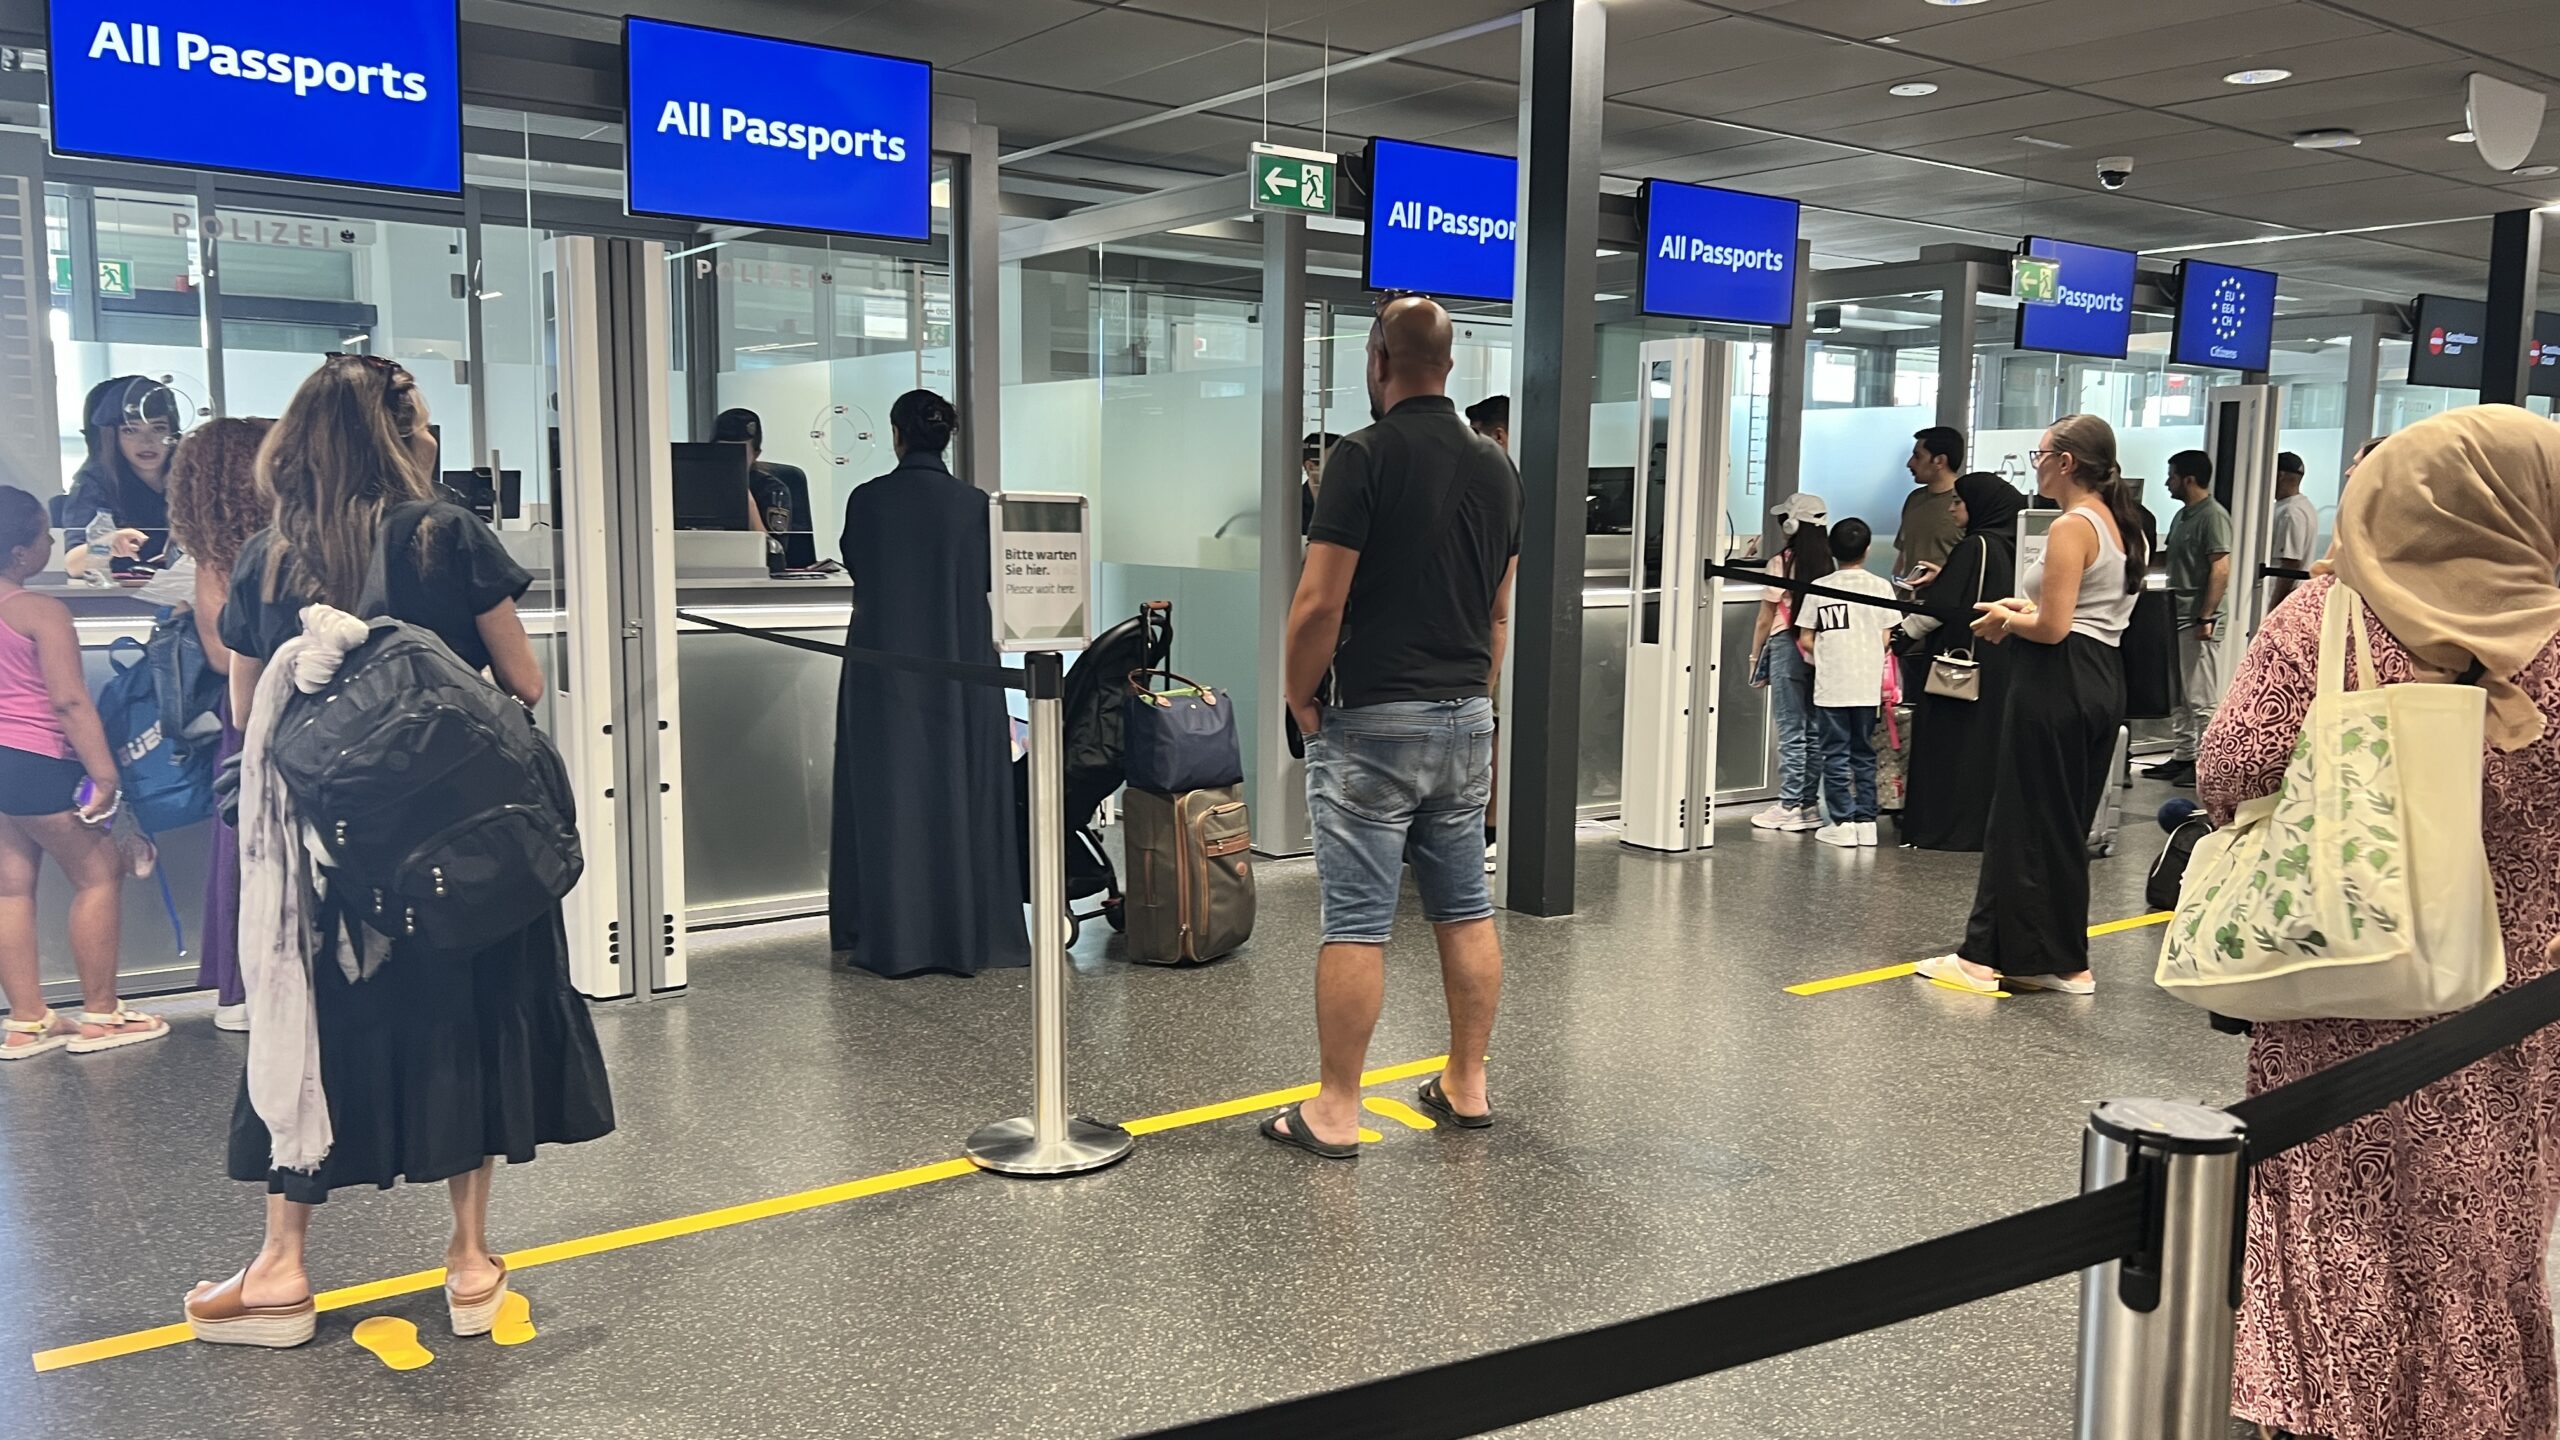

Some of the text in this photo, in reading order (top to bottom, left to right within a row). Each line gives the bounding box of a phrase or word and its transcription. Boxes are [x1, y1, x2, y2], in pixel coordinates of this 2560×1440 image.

[88, 21, 427, 102] All Passports
[657, 100, 906, 162] All Passports
[172, 212, 330, 248] POLIZEI
[1387, 201, 1517, 244] All Passpor
[1658, 235, 1783, 273] All Passports
[2057, 285, 2124, 314] Passports
[2224, 290, 2236, 302] EU
[2221, 303, 2236, 315] EEA
[2221, 315, 2233, 327] CH
[1005, 549, 1077, 561] Bitte warten
[1005, 564, 1051, 576] Sie hier.
[1006, 584, 1034, 594] Please
[1035, 585, 1055, 594] wait
[1819, 605, 1846, 630] NY
